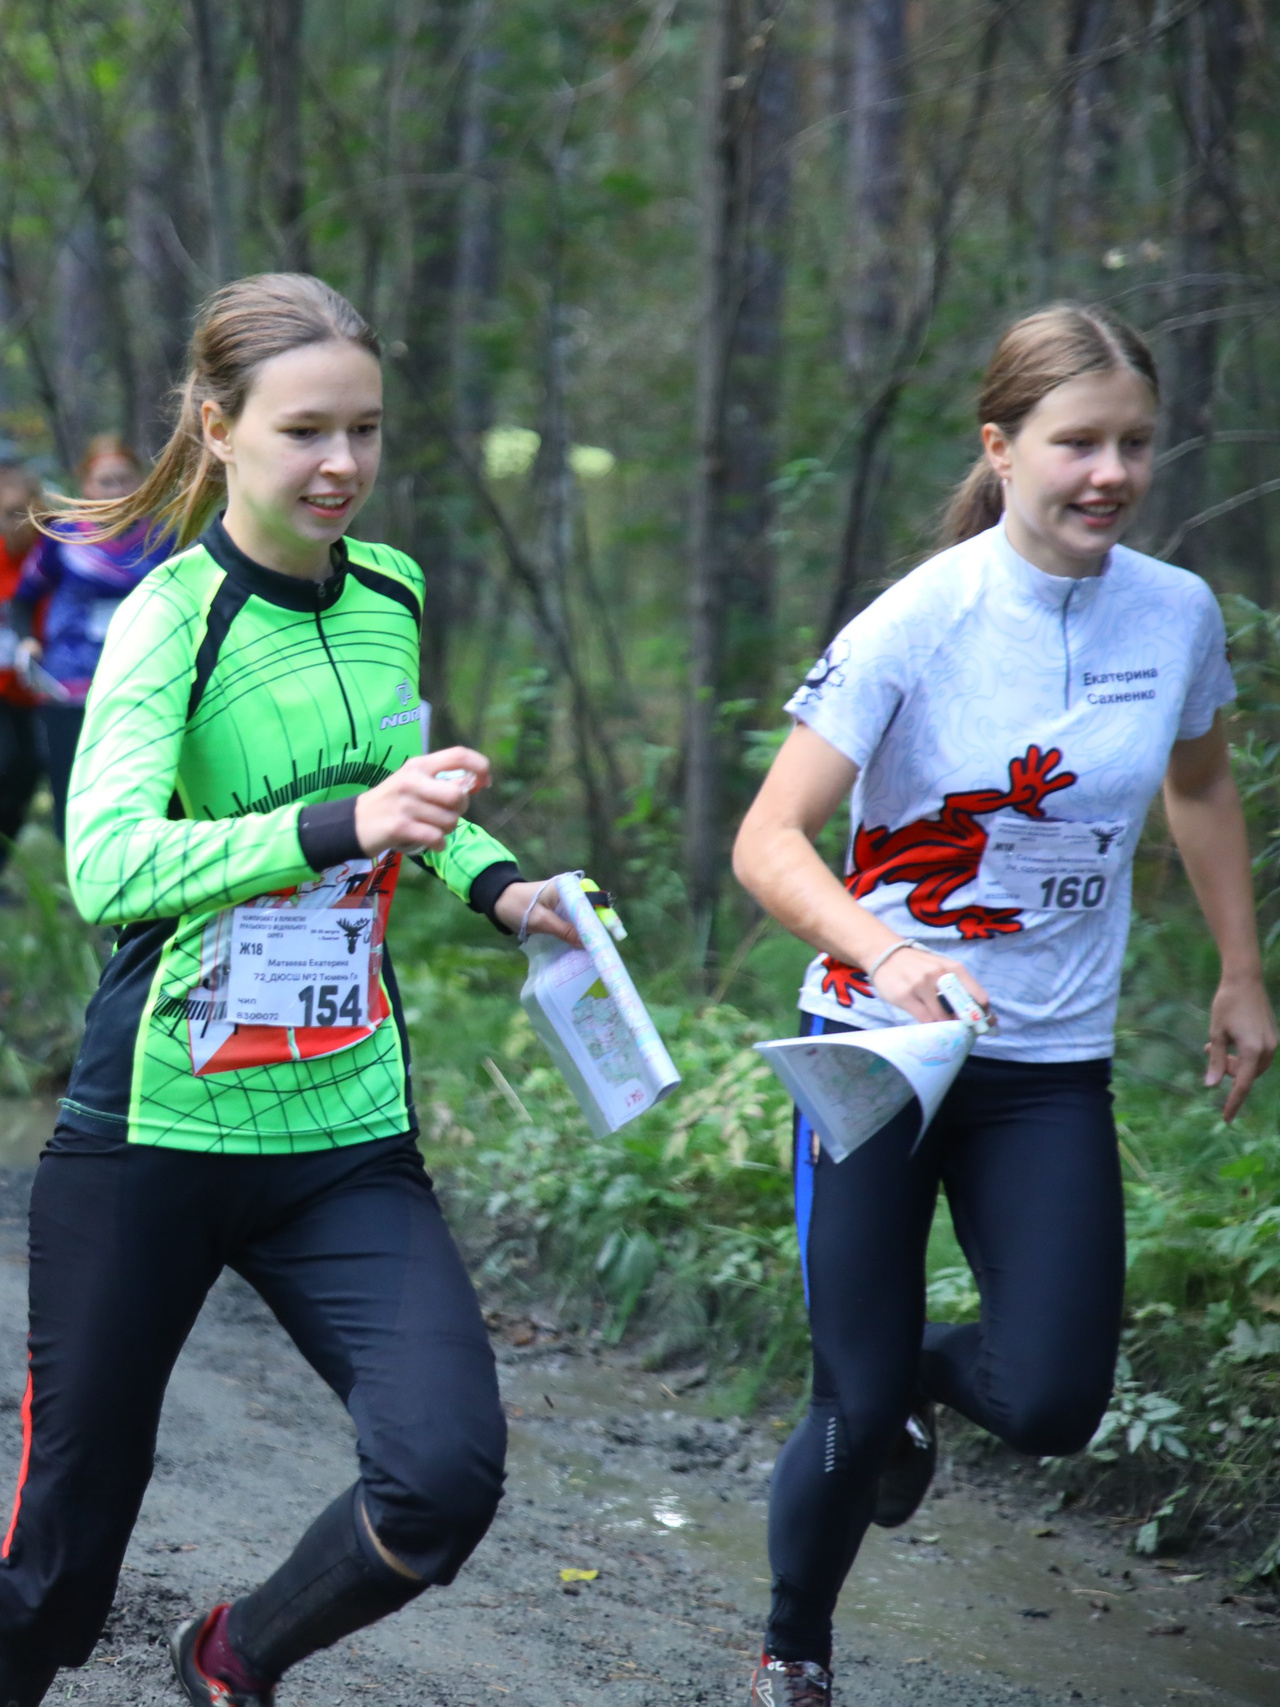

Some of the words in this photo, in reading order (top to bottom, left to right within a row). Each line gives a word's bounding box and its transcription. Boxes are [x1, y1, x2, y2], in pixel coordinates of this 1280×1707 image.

[1083, 667, 1158, 686] Екатерина
[1087, 689, 1156, 704] Сахненко
[380, 704, 421, 731] NOR
[1041, 875, 1106, 909] 160
[239, 942, 263, 956] Ж18
[268, 959, 307, 967] Матвеева
[309, 959, 349, 968] Екатерина
[320, 973, 349, 981] Тюмень
[298, 984, 362, 1027] 154
